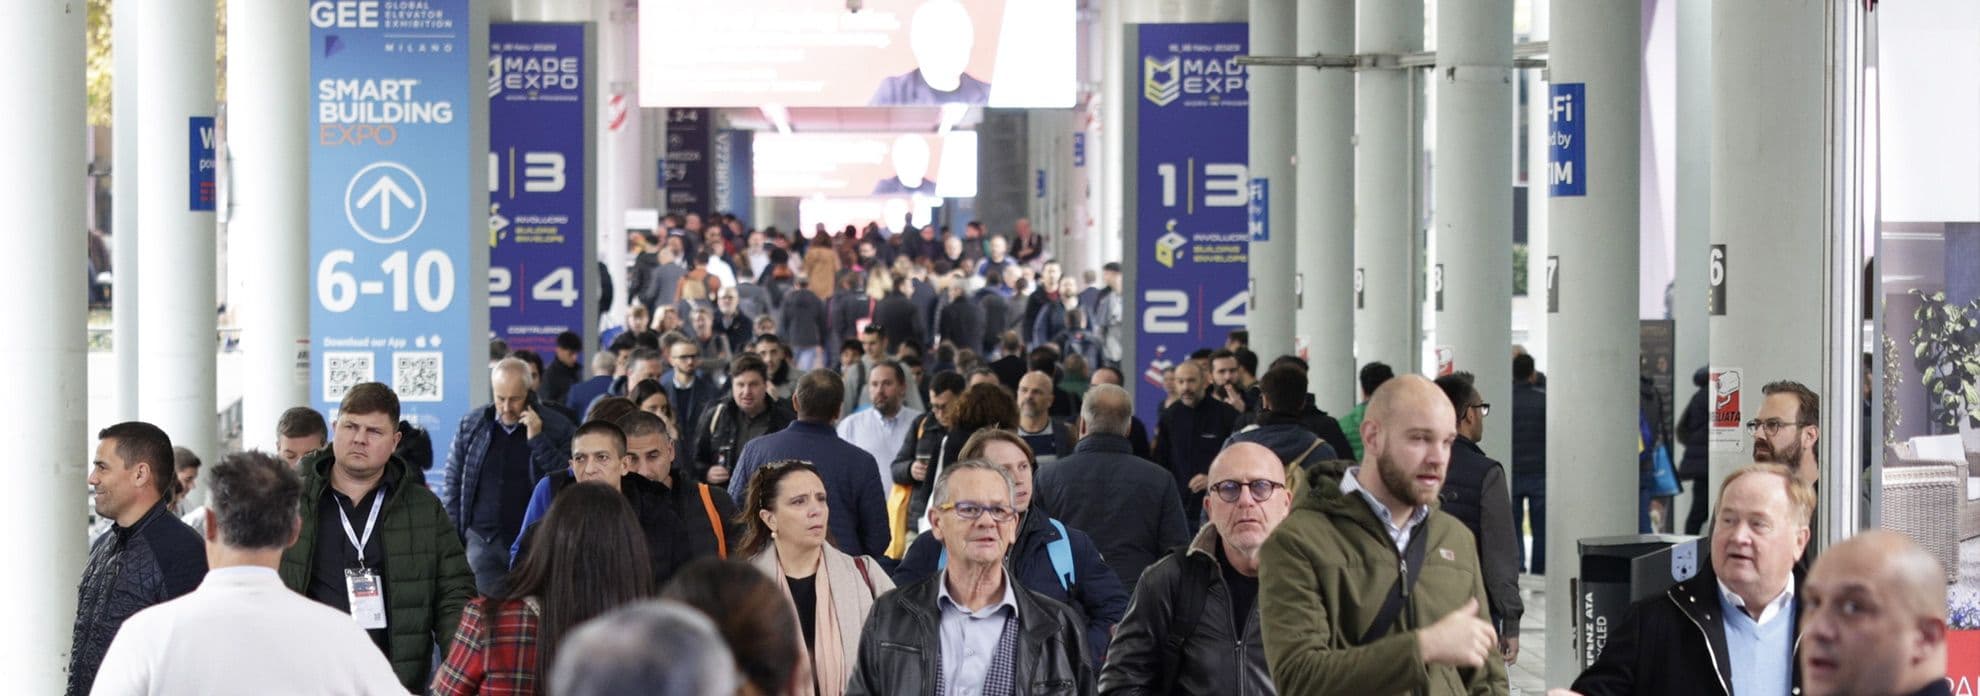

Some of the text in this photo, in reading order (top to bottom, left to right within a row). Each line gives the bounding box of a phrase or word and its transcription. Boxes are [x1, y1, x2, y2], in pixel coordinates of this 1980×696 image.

[310, 1, 379, 28] GEE
[384, 10, 443, 19] ELEVATOR
[384, 20, 453, 28] EXHIBITION
[384, 43, 453, 52] MILANO
[504, 57, 578, 73] MADE
[1183, 59, 1248, 75] MAD
[319, 79, 418, 100] SMART
[504, 74, 579, 89] EXPO
[1183, 77, 1248, 93] EXP
[319, 101, 454, 124] BUILDING
[320, 124, 398, 145] EXPO
[1558, 131, 1572, 149] by
[525, 152, 566, 192] 3
[1158, 163, 1248, 207] 1 3
[1548, 259, 1557, 289] 7
[1710, 248, 1724, 286] 6
[317, 249, 455, 312] 6-10
[532, 267, 579, 308] 4
[1143, 290, 1189, 333] 2
[324, 336, 407, 349] Download our App
[1584, 591, 1594, 620] ATA
